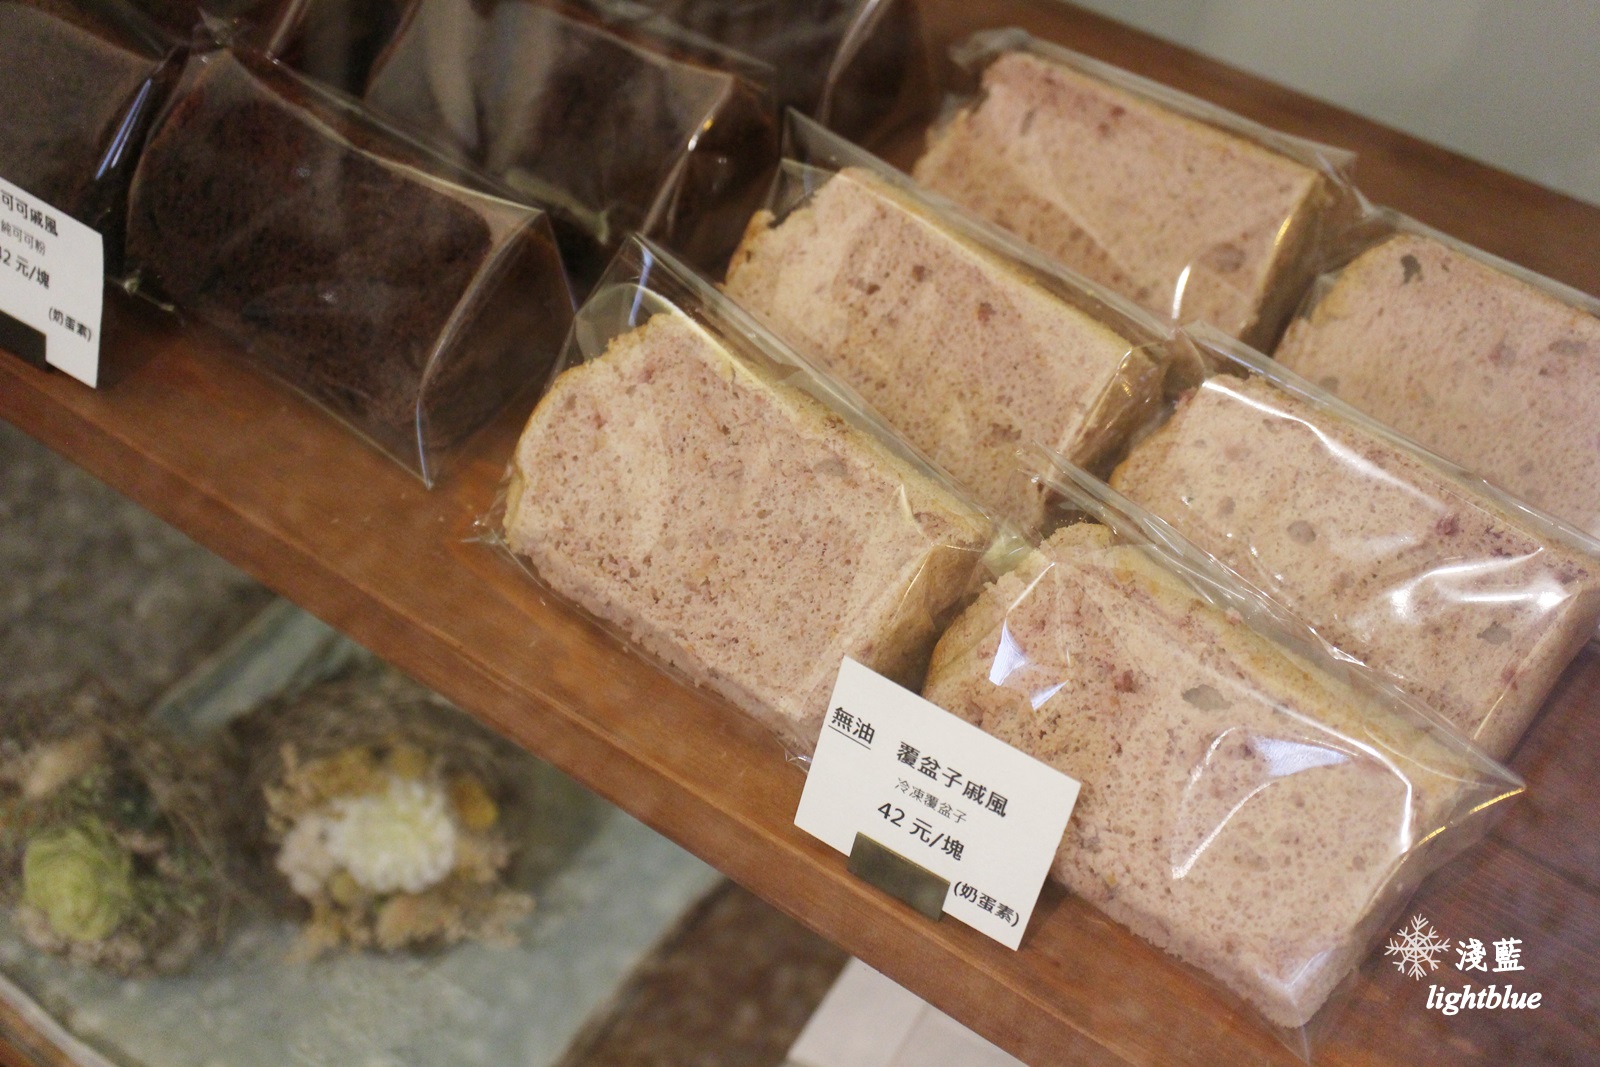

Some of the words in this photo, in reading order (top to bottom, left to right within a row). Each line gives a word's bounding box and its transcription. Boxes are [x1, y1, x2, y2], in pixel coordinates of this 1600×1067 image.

[1, 190, 58, 236] 可可戚風
[48, 307, 93, 342] (奶蛋素)
[832, 707, 876, 745] 無油
[896, 741, 1009, 818] 覆盆子戚風
[894, 777, 967, 823] 冷凍覆盆子
[877, 802, 905, 828] 42
[909, 818, 965, 862] 元/塊
[953, 881, 1020, 928] (奶蛋素)
